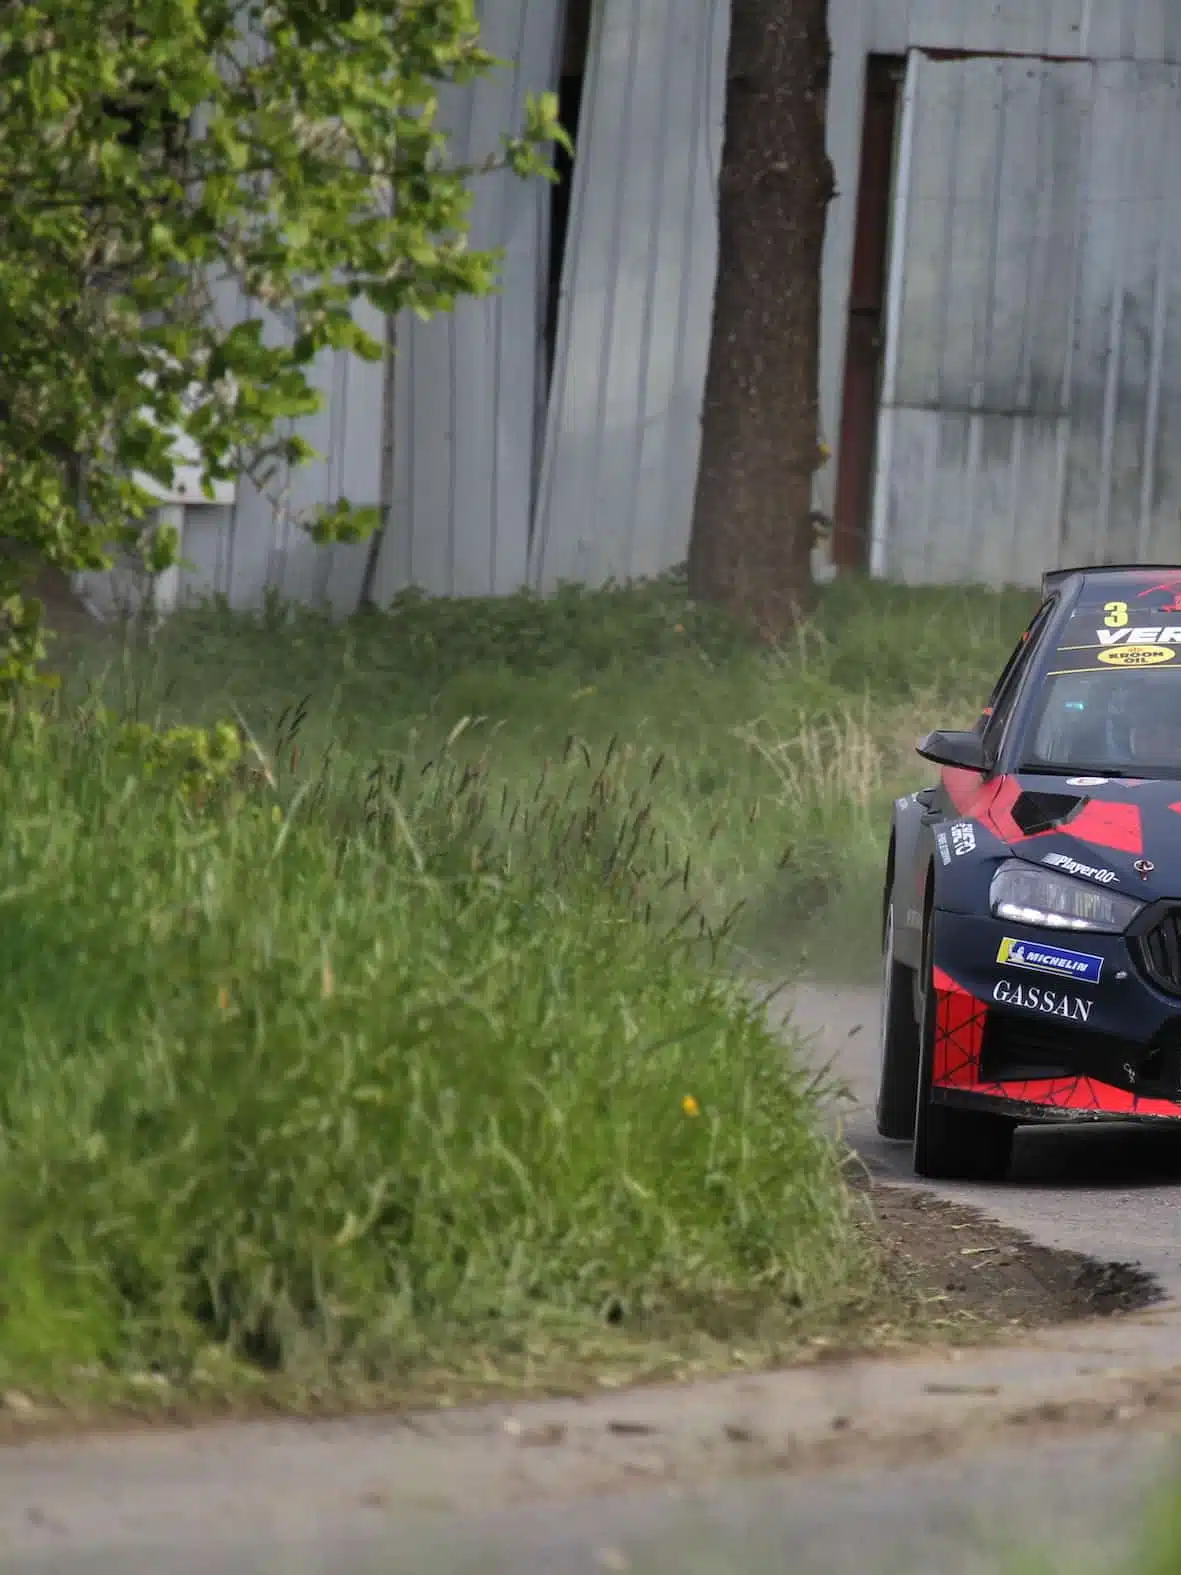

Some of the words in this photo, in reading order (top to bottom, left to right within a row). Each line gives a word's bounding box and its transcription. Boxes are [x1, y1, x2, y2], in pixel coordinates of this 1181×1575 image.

[1103, 601, 1129, 628] 3
[1108, 651, 1165, 659] KROON
[1026, 951, 1089, 972] MICHELIN
[992, 979, 1094, 1022] GASSAN
